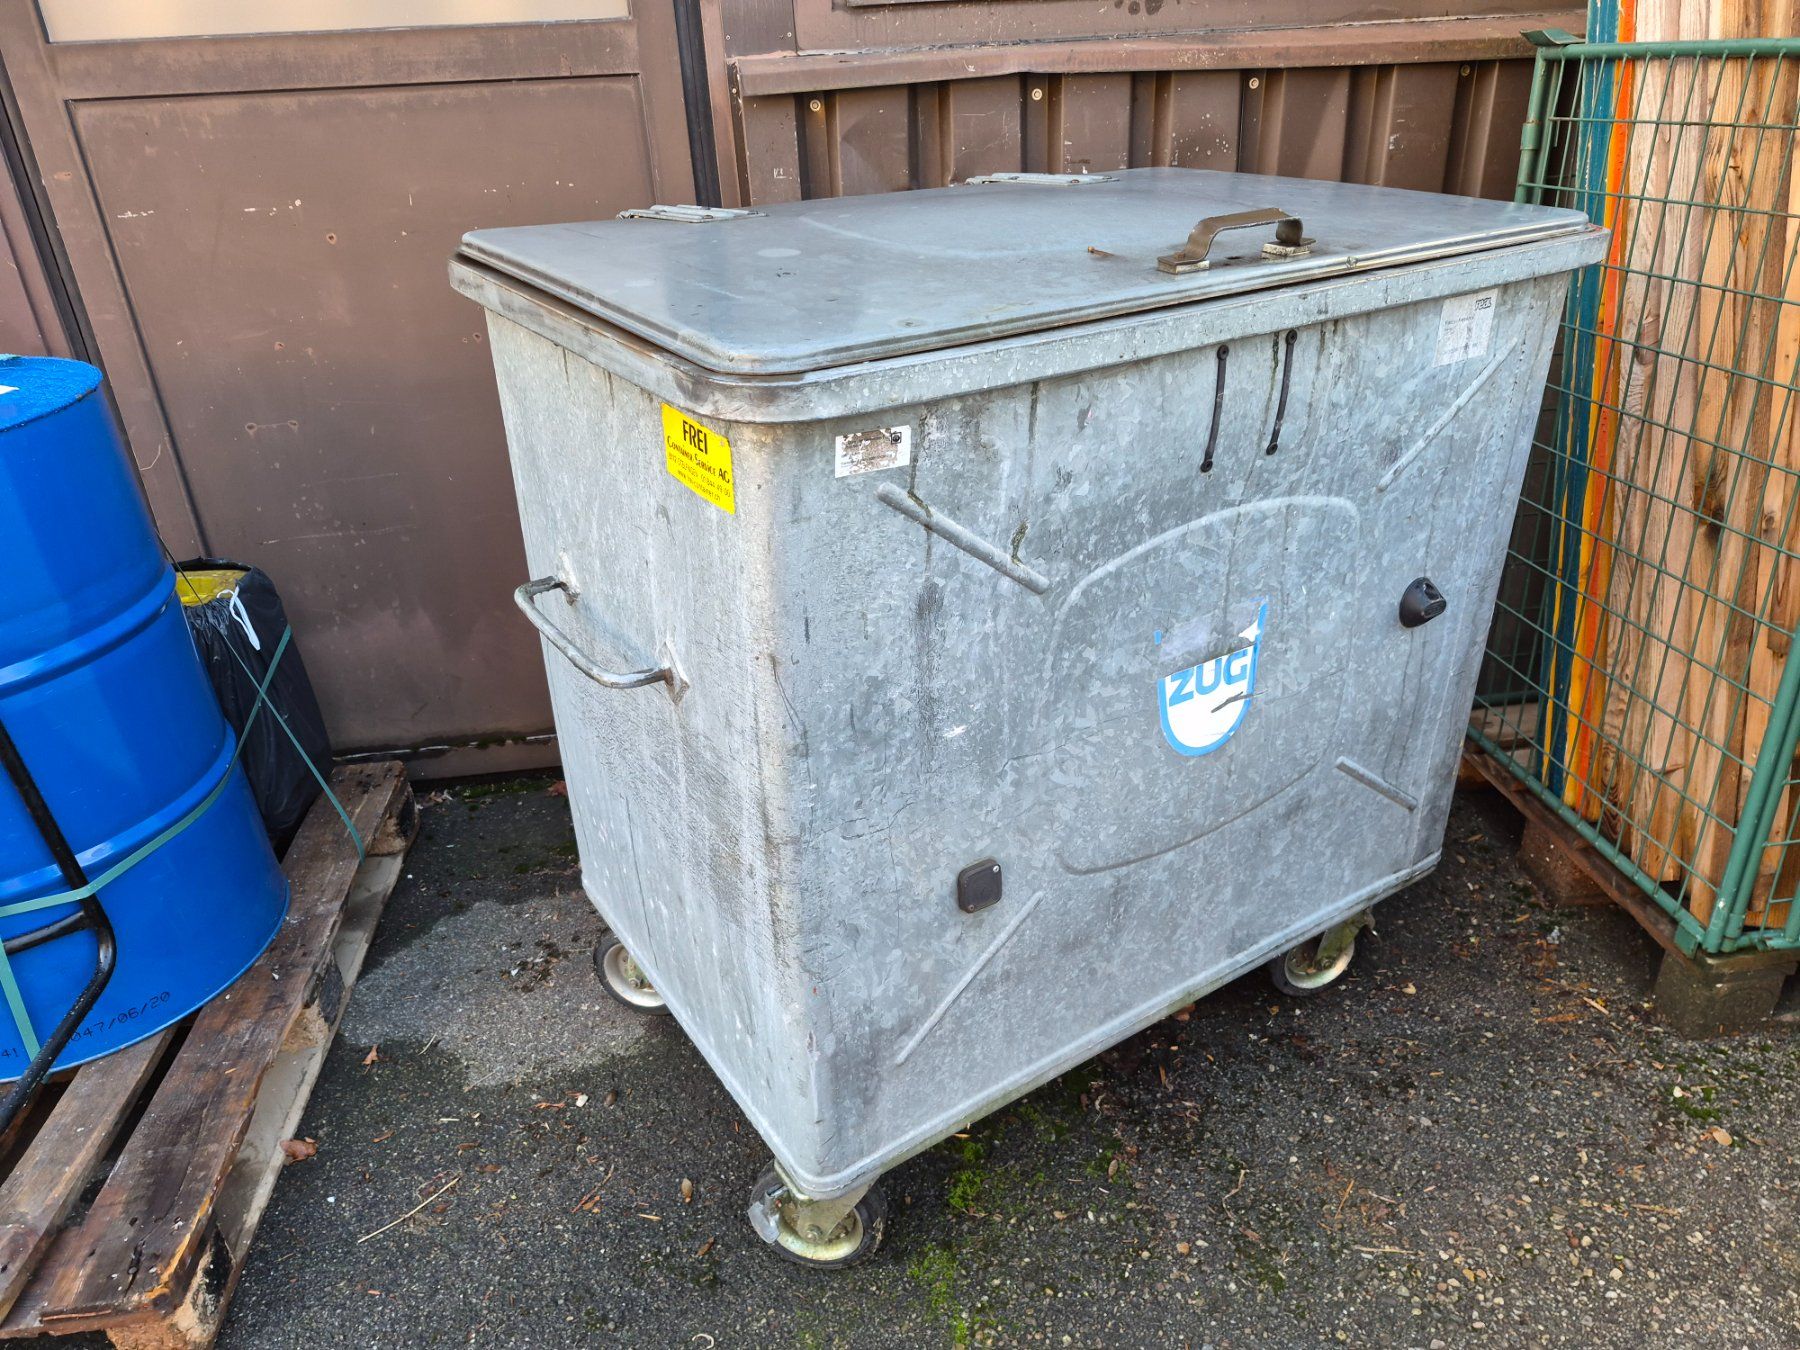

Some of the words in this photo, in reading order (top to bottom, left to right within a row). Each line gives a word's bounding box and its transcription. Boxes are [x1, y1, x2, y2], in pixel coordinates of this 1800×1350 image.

[682, 420, 708, 455] FREI
[718, 467, 730, 484] AG
[1169, 648, 1248, 708] ZUG
